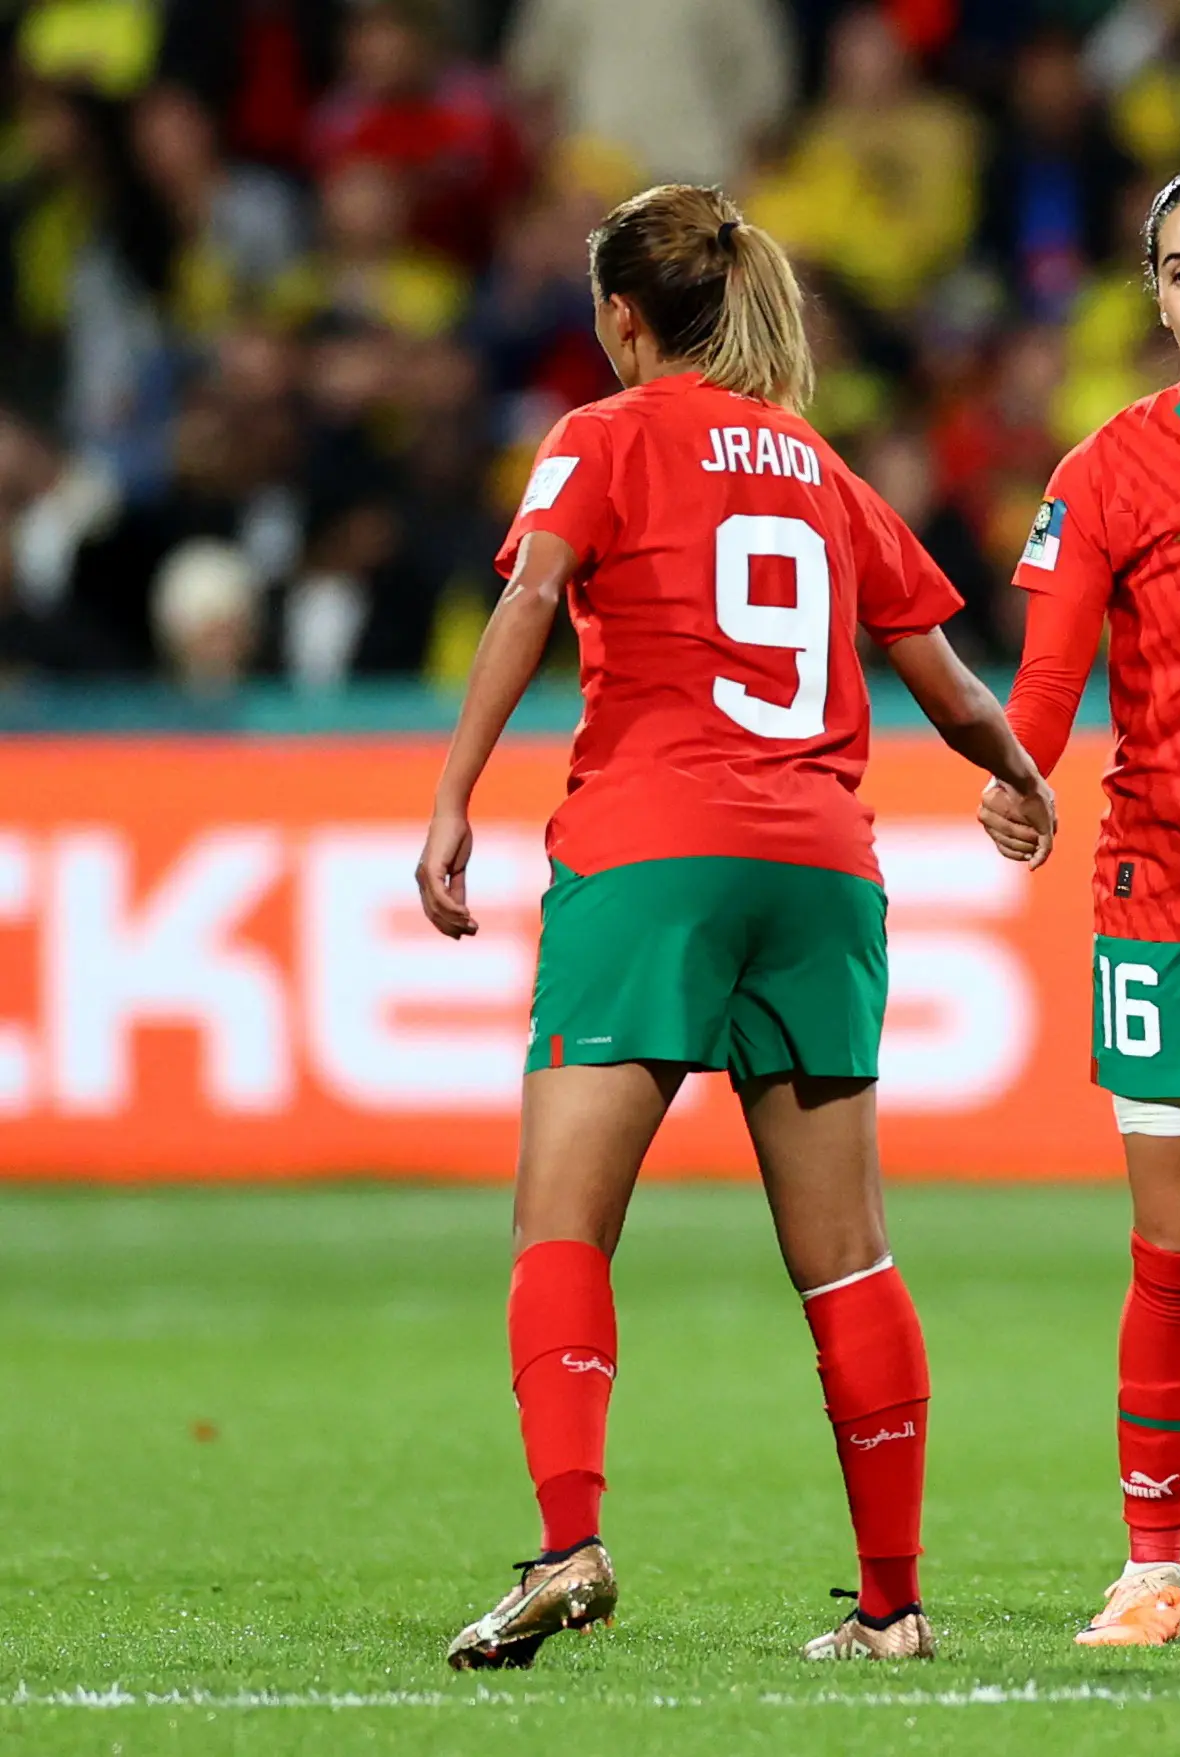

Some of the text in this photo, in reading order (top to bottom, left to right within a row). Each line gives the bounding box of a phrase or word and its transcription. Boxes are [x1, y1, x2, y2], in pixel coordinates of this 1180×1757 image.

[700, 426, 822, 486] JRAIDI
[713, 514, 830, 739] 9
[1098, 955, 1161, 1057] 16
[561, 1352, 614, 1380] لمغرب
